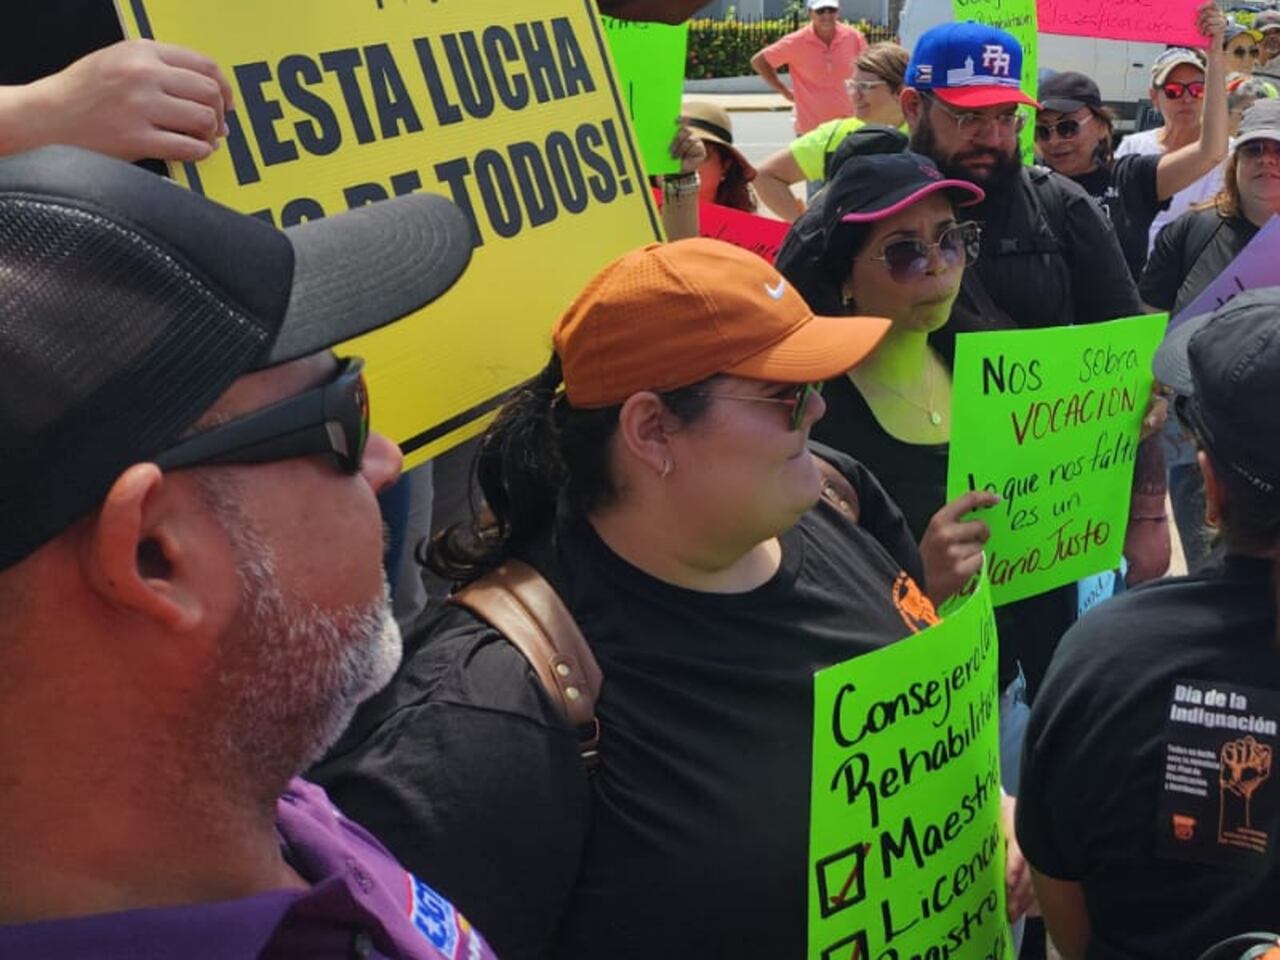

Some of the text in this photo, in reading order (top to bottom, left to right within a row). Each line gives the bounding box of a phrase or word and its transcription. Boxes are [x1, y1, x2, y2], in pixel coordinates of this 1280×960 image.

[418, 16, 598, 128] LUCHA
[434, 118, 634, 248] TODOS!
[1003, 474, 1039, 515] que
[1011, 507, 1039, 531] es
[1174, 684, 1248, 711] Día de la
[1169, 703, 1278, 736] Indignación
